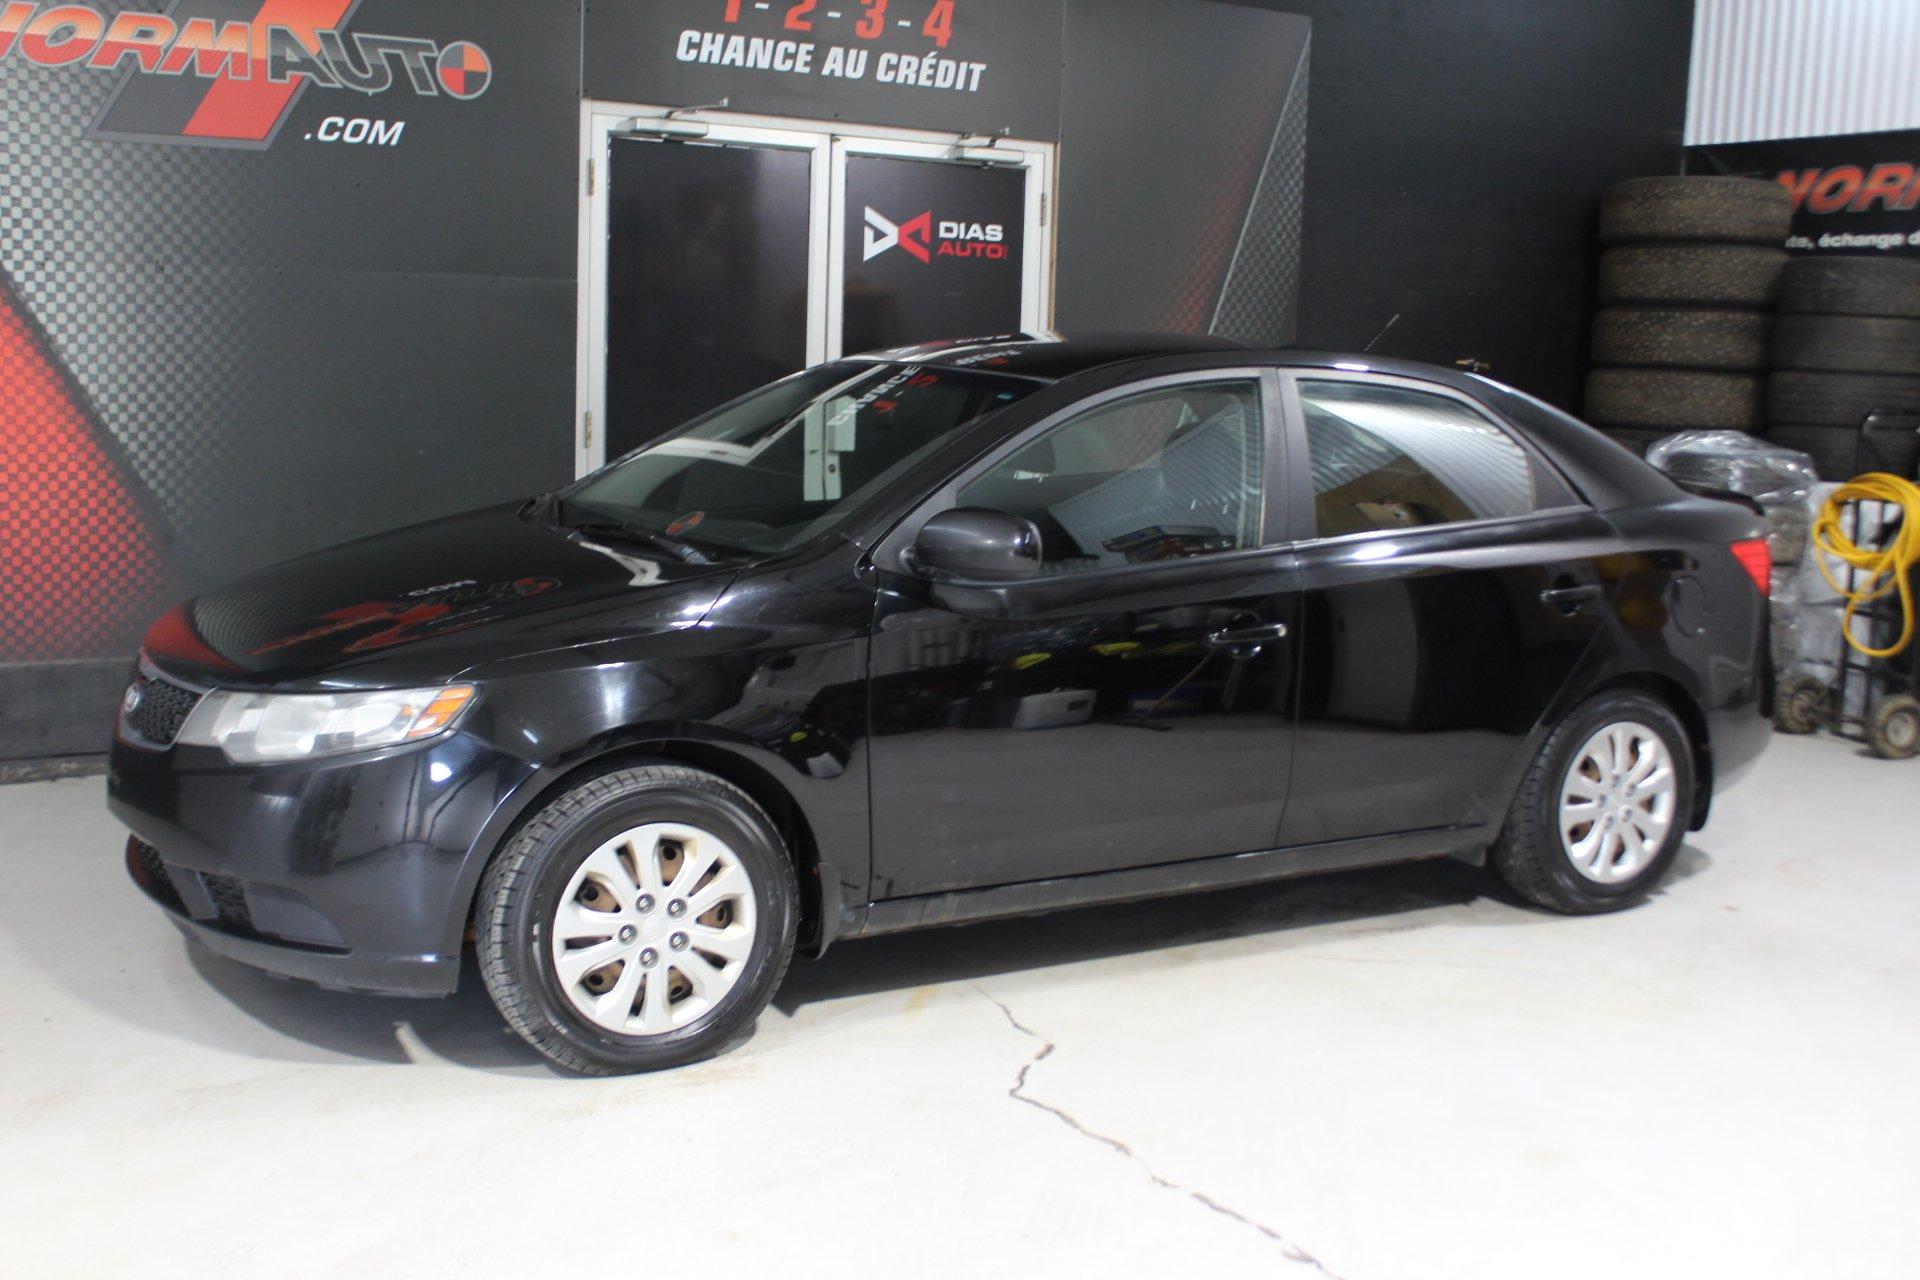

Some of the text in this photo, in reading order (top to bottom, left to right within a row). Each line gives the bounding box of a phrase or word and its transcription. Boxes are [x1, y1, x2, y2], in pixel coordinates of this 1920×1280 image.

[676, 30, 987, 92] CHANCE AU CRÉDIT
[304, 116, 405, 146] .COM
[938, 220, 1004, 242] DIAS
[1818, 232, 1905, 250] échange
[937, 240, 1003, 260] AUTO
